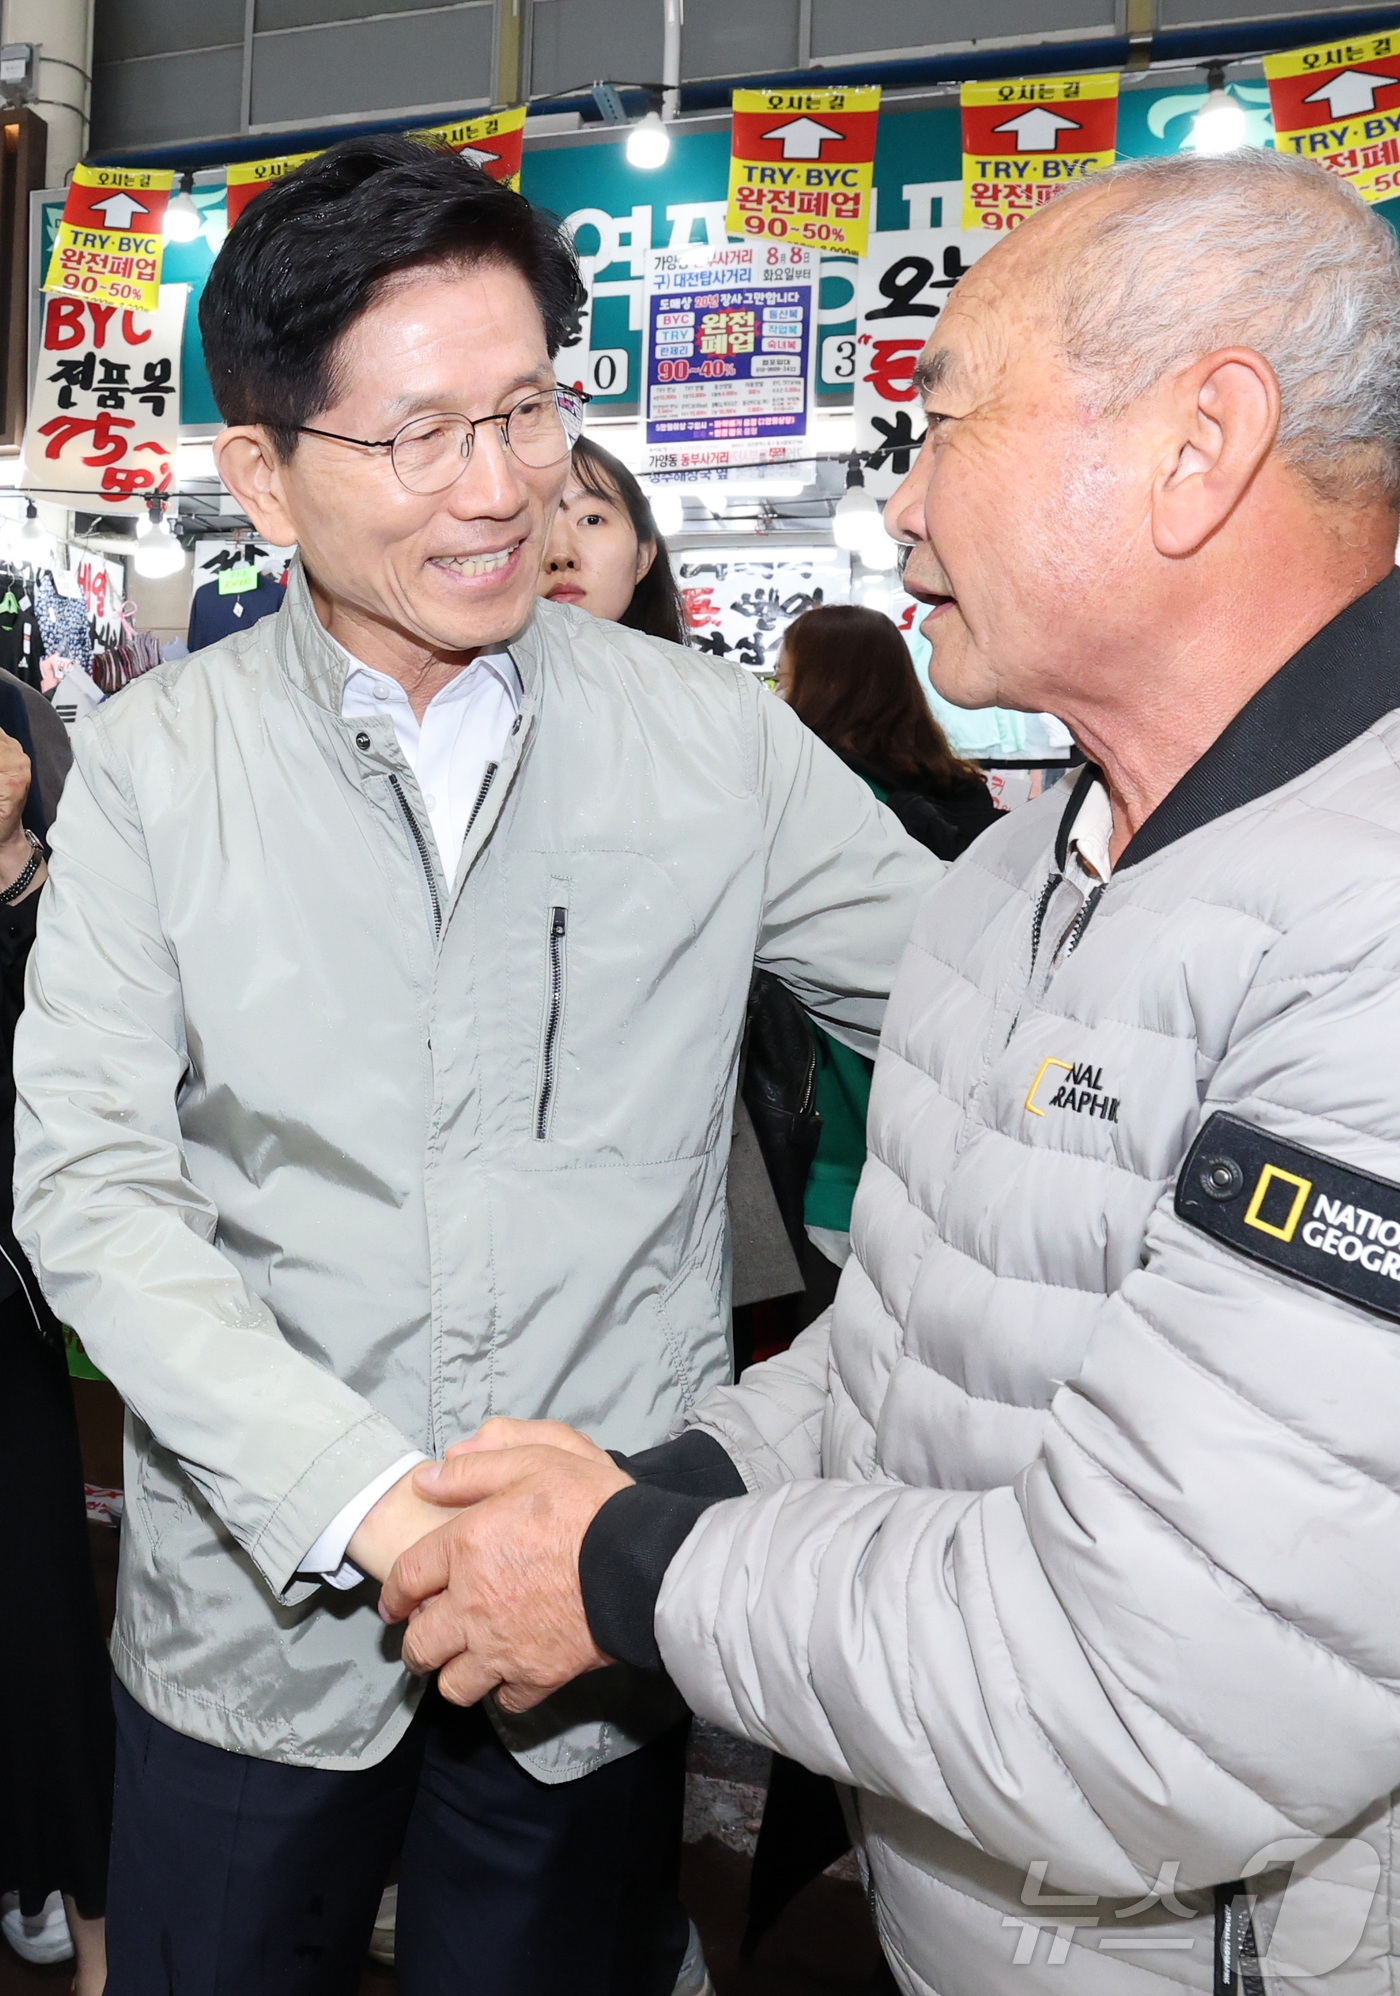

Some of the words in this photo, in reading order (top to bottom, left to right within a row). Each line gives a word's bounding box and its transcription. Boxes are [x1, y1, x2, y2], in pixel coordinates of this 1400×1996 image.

[1302, 46, 1365, 71] 오시는
[1372, 36, 1392, 57] 길
[766, 94, 822, 111] 오시는
[828, 94, 845, 110] 길
[997, 84, 1055, 102] 오시는
[1063, 81, 1081, 98] 길
[97, 172, 136, 188] 오시는
[139, 173, 151, 188] 길
[735, 186, 862, 220] 완전폐업
[743, 214, 846, 243] 90~50%
[59, 247, 157, 283] 완전폐업
[654, 255, 689, 271] 가양
[61, 272, 143, 301] 90~50%
[653, 274, 671, 290] 구)
[673, 267, 752, 288] 대전탑사거리
[658, 297, 693, 312] 도매상
[694, 293, 720, 309] 20년
[720, 292, 743, 308] 장사
[743, 290, 801, 306] 그만합니다
[44, 296, 153, 351] BYC
[662, 313, 690, 326] BYC
[700, 311, 756, 336] 완전
[662, 330, 689, 342] TRY
[699, 331, 756, 355] 폐업
[593, 355, 617, 390] 0
[657, 358, 737, 382] 90~40%
[45, 351, 176, 417] 전품목
[648, 454, 678, 468] 가양동
[680, 451, 730, 467] 동부사거리
